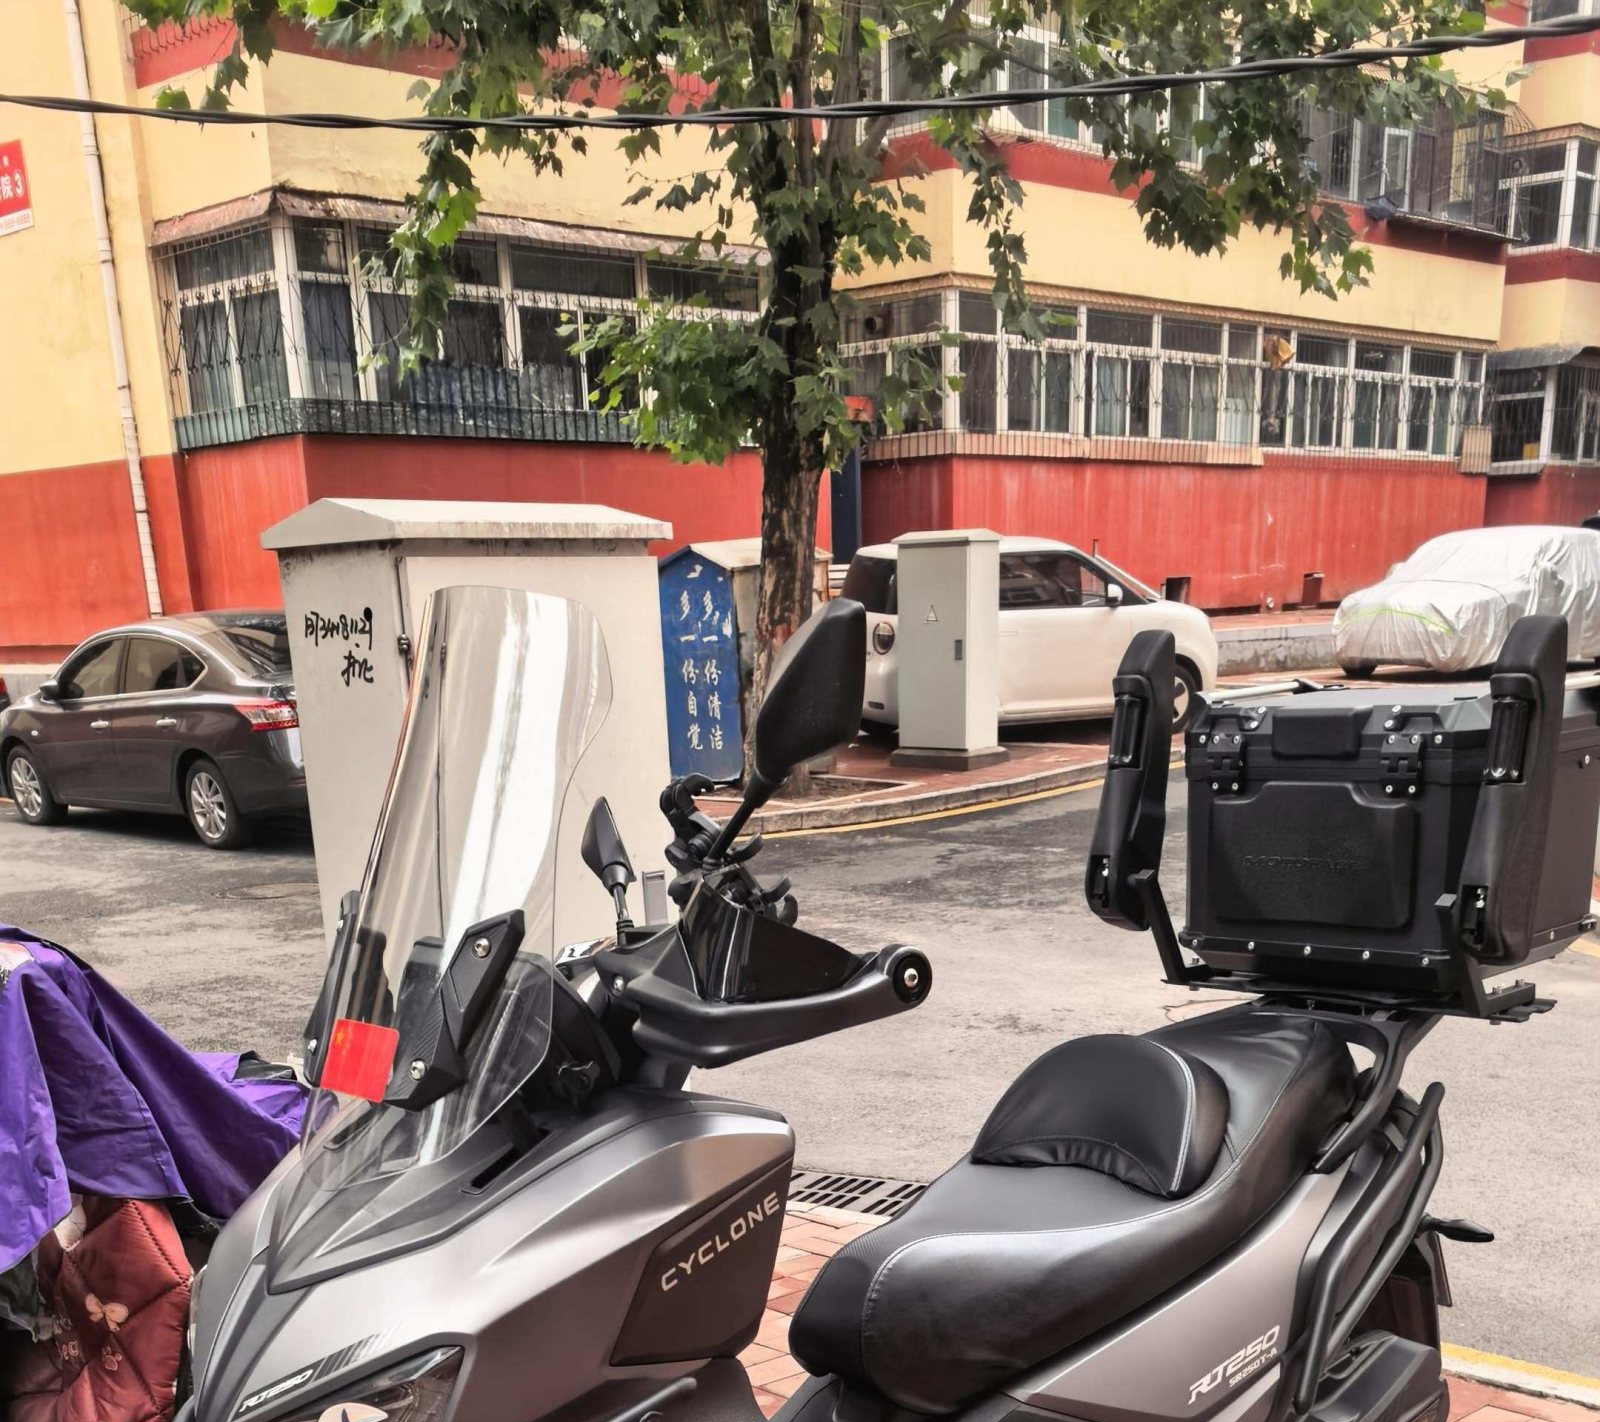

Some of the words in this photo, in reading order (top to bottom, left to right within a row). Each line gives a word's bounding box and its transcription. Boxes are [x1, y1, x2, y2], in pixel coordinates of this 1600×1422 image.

[679, 590, 703, 750] 多一份自觉
[702, 590, 723, 750] 多一份清洁
[661, 1191, 780, 1291] CYCLONE
[238, 1368, 313, 1413] RT250
[1187, 1325, 1280, 1405] RT250
[1229, 1346, 1278, 1388] SR250T-A
